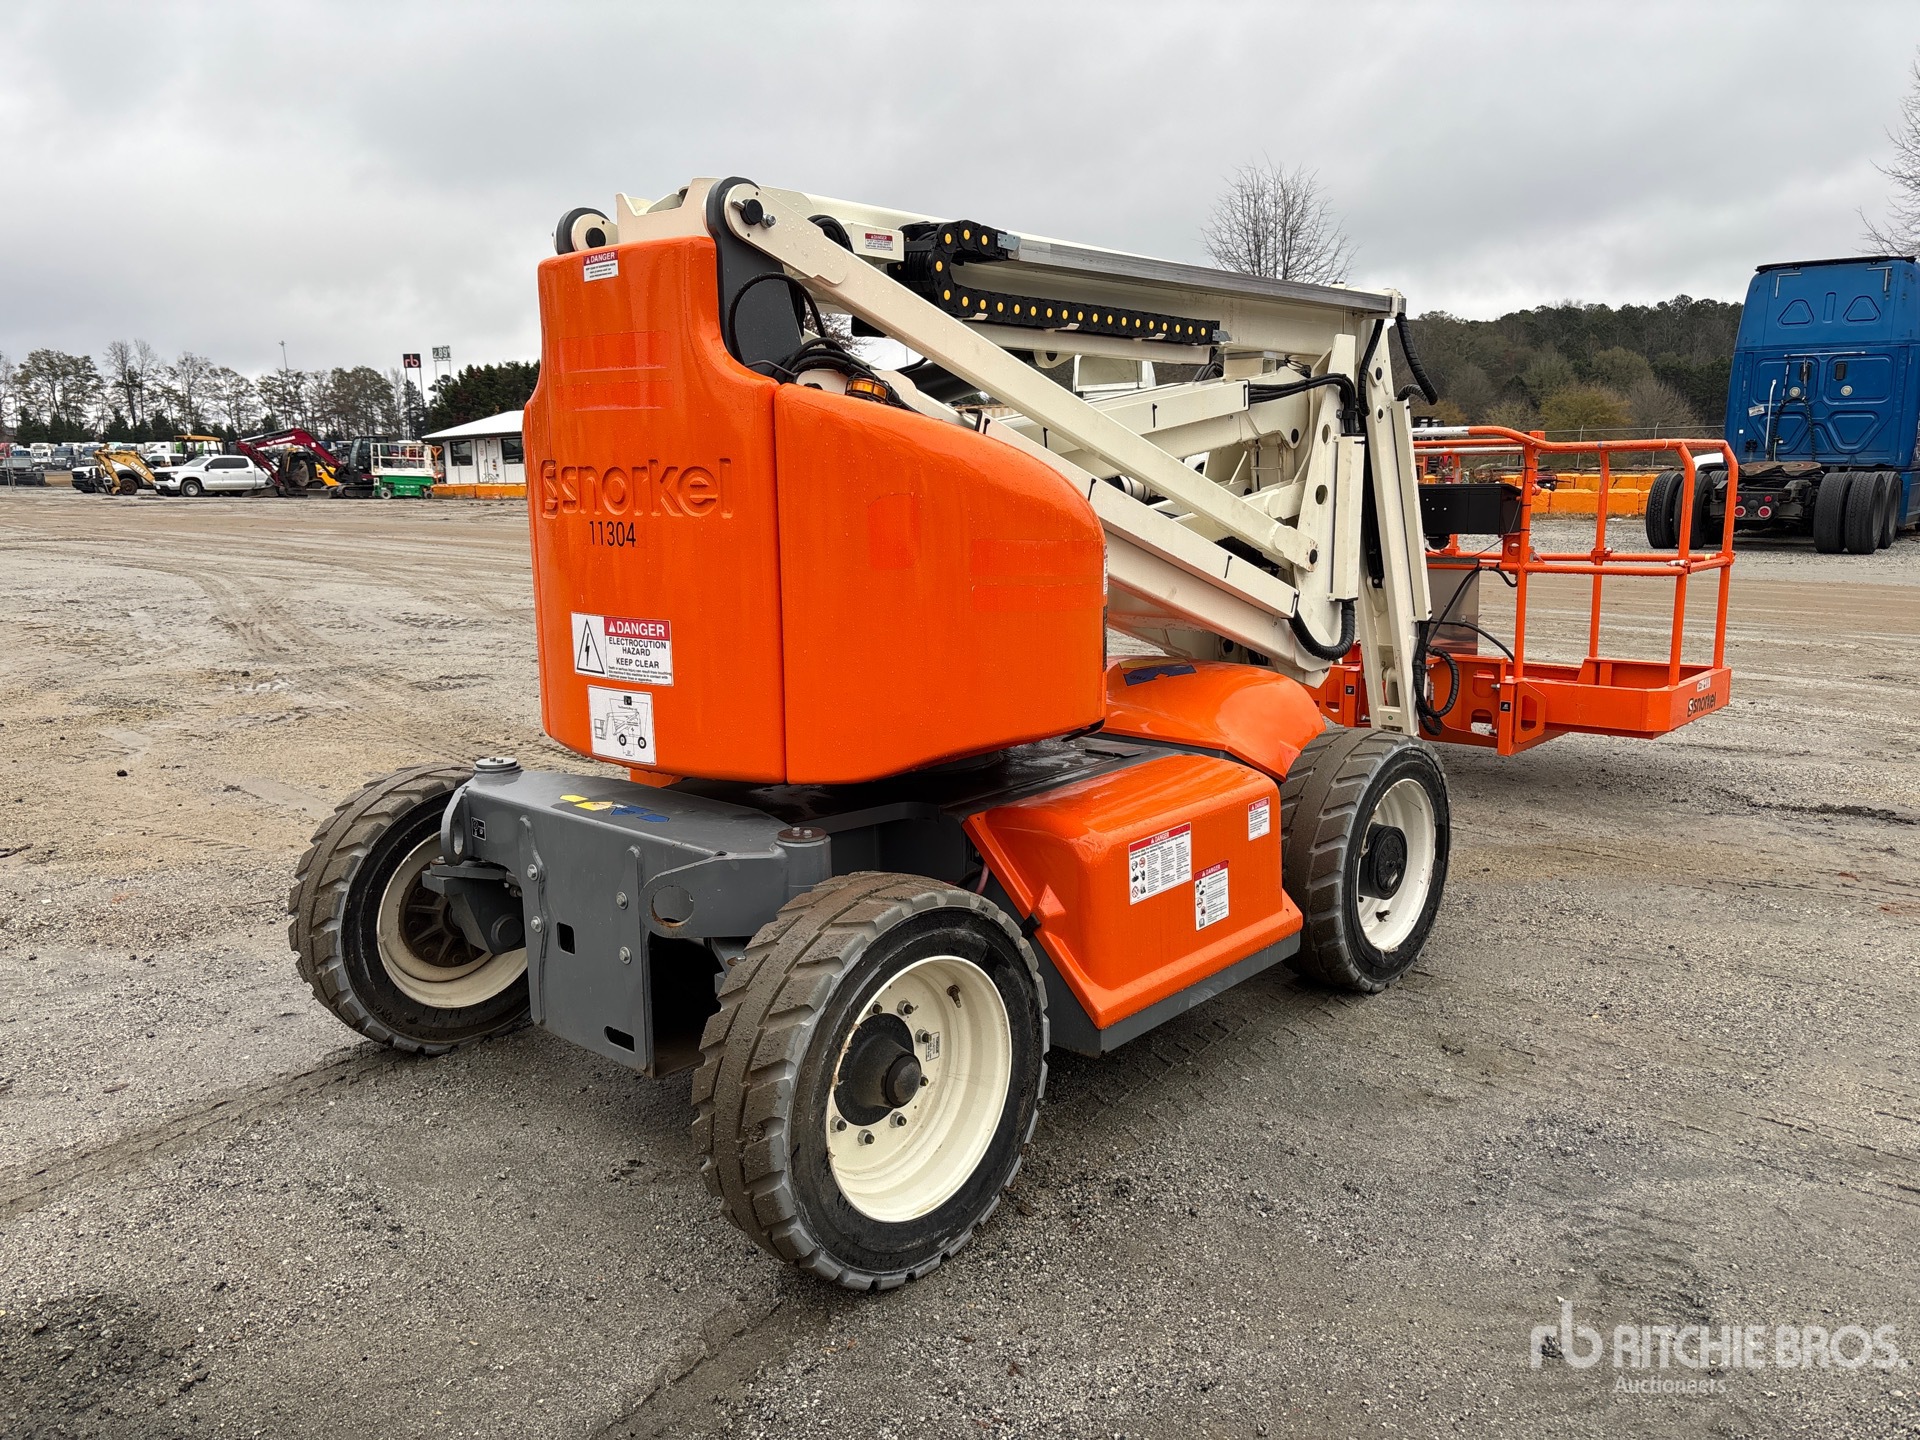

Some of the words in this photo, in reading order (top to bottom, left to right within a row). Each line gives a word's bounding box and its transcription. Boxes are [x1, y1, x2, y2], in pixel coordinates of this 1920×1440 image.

[590, 251, 616, 263] DANGER
[588, 520, 637, 548] 11304
[616, 620, 665, 637] DANGER
[608, 636, 667, 650] ELECTROCUTION
[622, 647, 651, 657] HAZARD
[615, 657, 634, 666] KEEP
[634, 659, 660, 669] CLEAR
[1154, 831, 1170, 843] DANGER
[1205, 864, 1221, 876] DANGER
